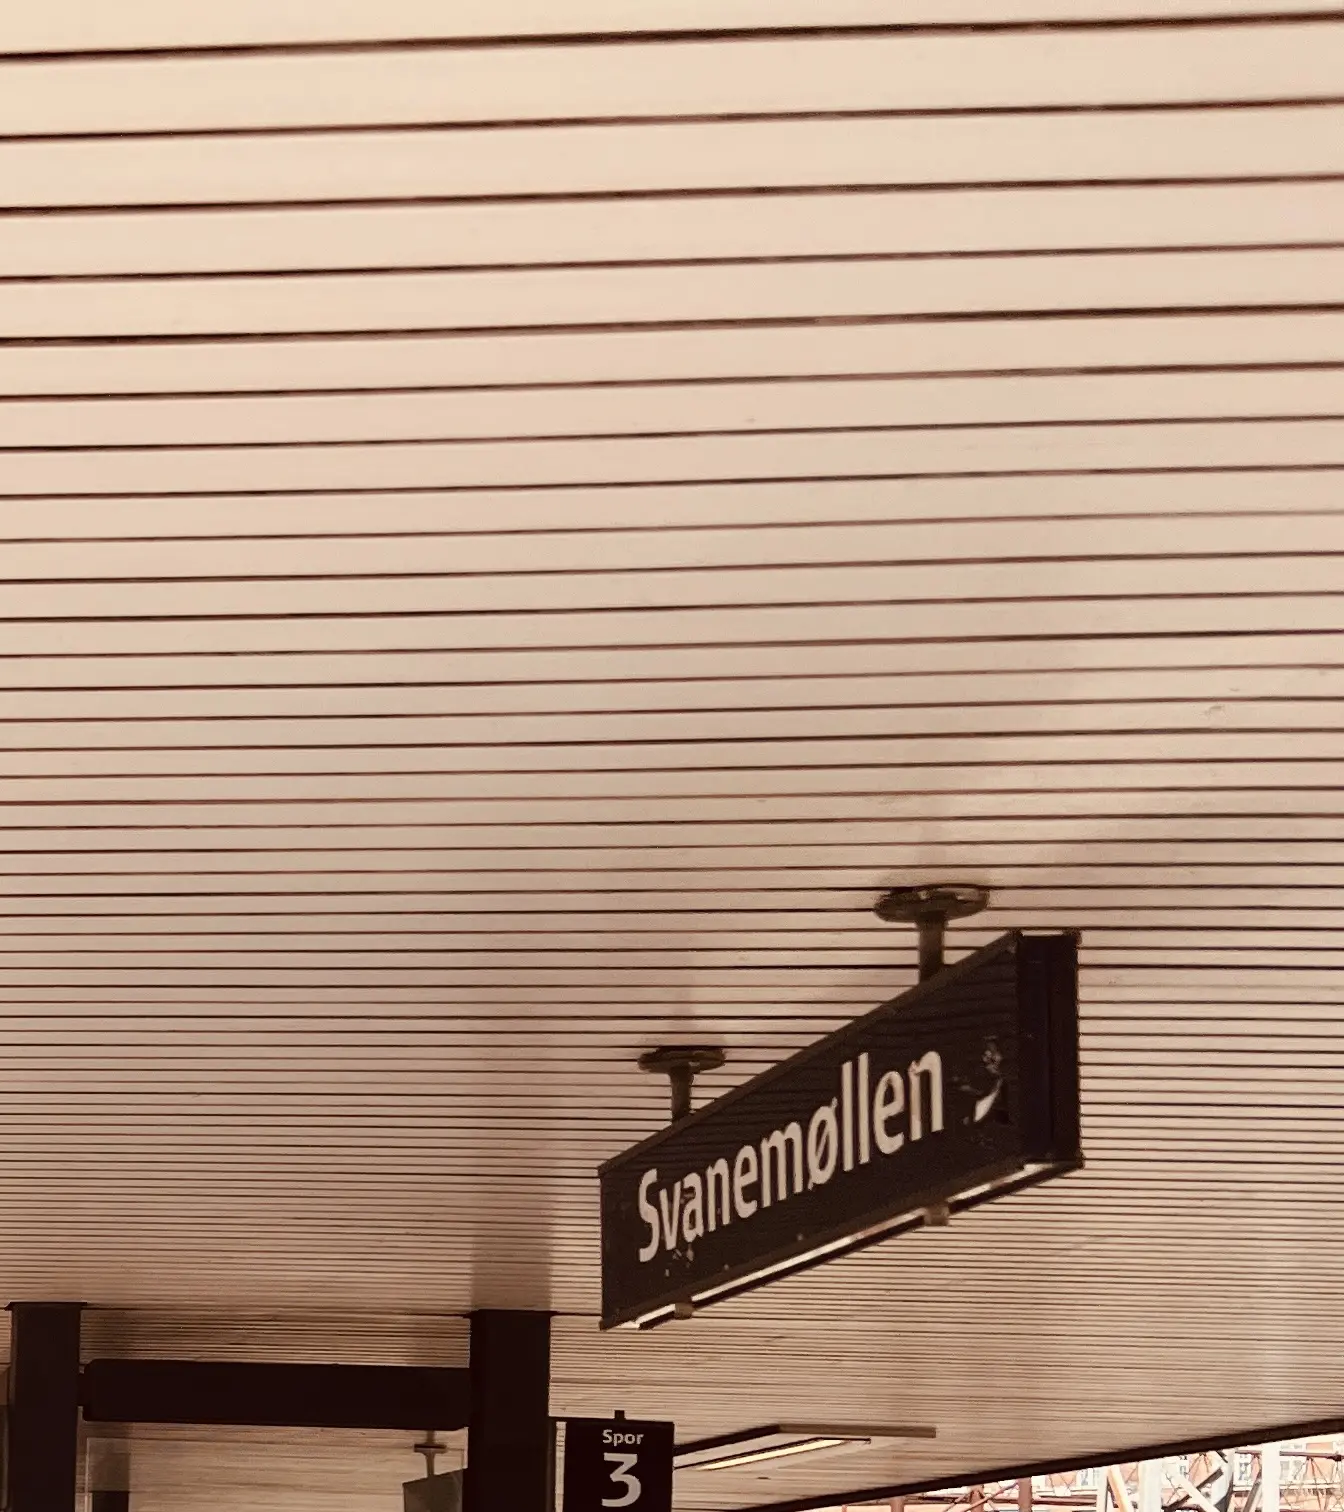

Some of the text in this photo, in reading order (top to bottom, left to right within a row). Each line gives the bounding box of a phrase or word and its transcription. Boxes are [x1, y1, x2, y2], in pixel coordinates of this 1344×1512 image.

[638, 1050, 945, 1263] Svanemøllen
[602, 1429, 644, 1449] Spor
[601, 1452, 642, 1508] 3
